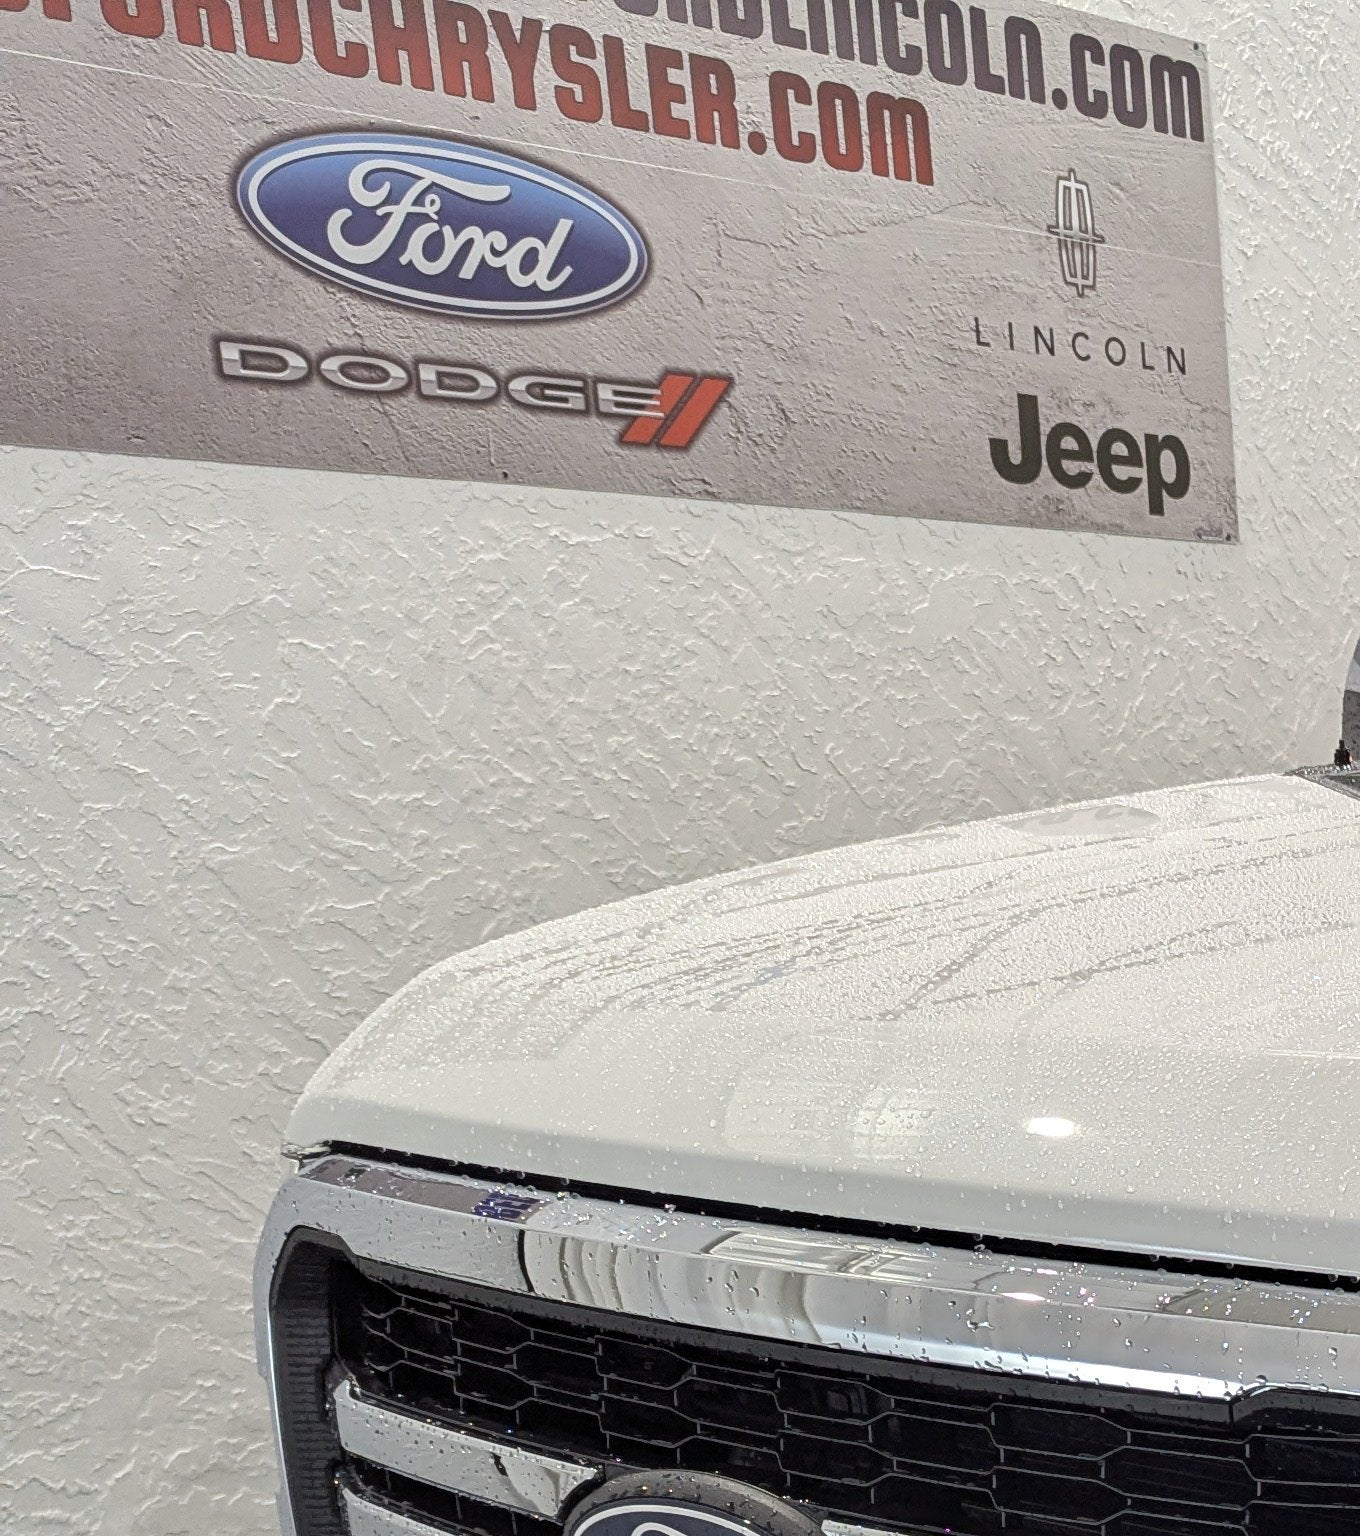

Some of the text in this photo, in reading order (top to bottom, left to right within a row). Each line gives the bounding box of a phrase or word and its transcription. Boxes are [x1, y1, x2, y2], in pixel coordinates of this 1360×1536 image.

[613, 0, 1205, 143] LINCOLN.COM
[327, 158, 574, 292] Ford
[218, 340, 665, 418] DODGE
[974, 316, 1188, 375] LINCOLN
[988, 392, 1191, 516] Jeep
